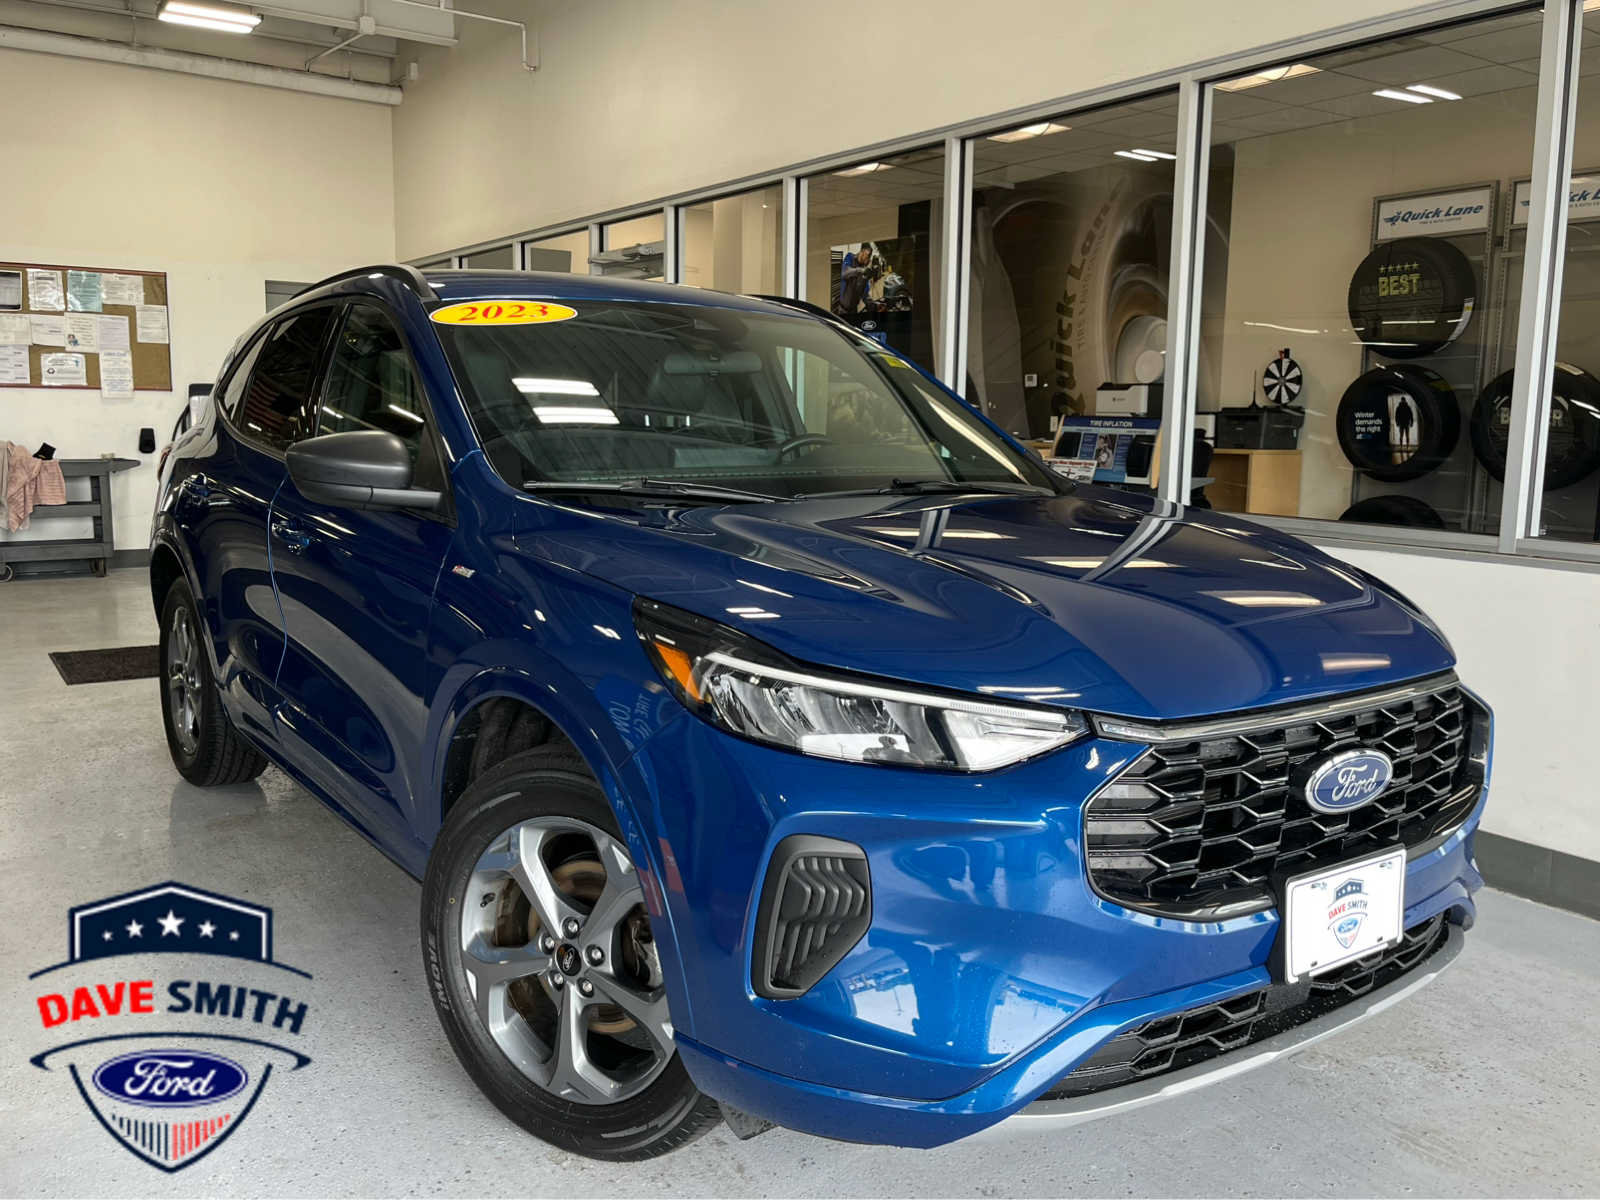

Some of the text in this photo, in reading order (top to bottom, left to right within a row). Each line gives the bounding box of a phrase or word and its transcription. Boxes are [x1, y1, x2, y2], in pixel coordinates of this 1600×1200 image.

[1400, 208, 1443, 223] Quick
[1444, 204, 1484, 217] Lane
[1378, 273, 1421, 297] BEST
[458, 304, 549, 321] 2023
[1331, 764, 1379, 802] Ford
[1328, 899, 1368, 920] DAVE SMITH
